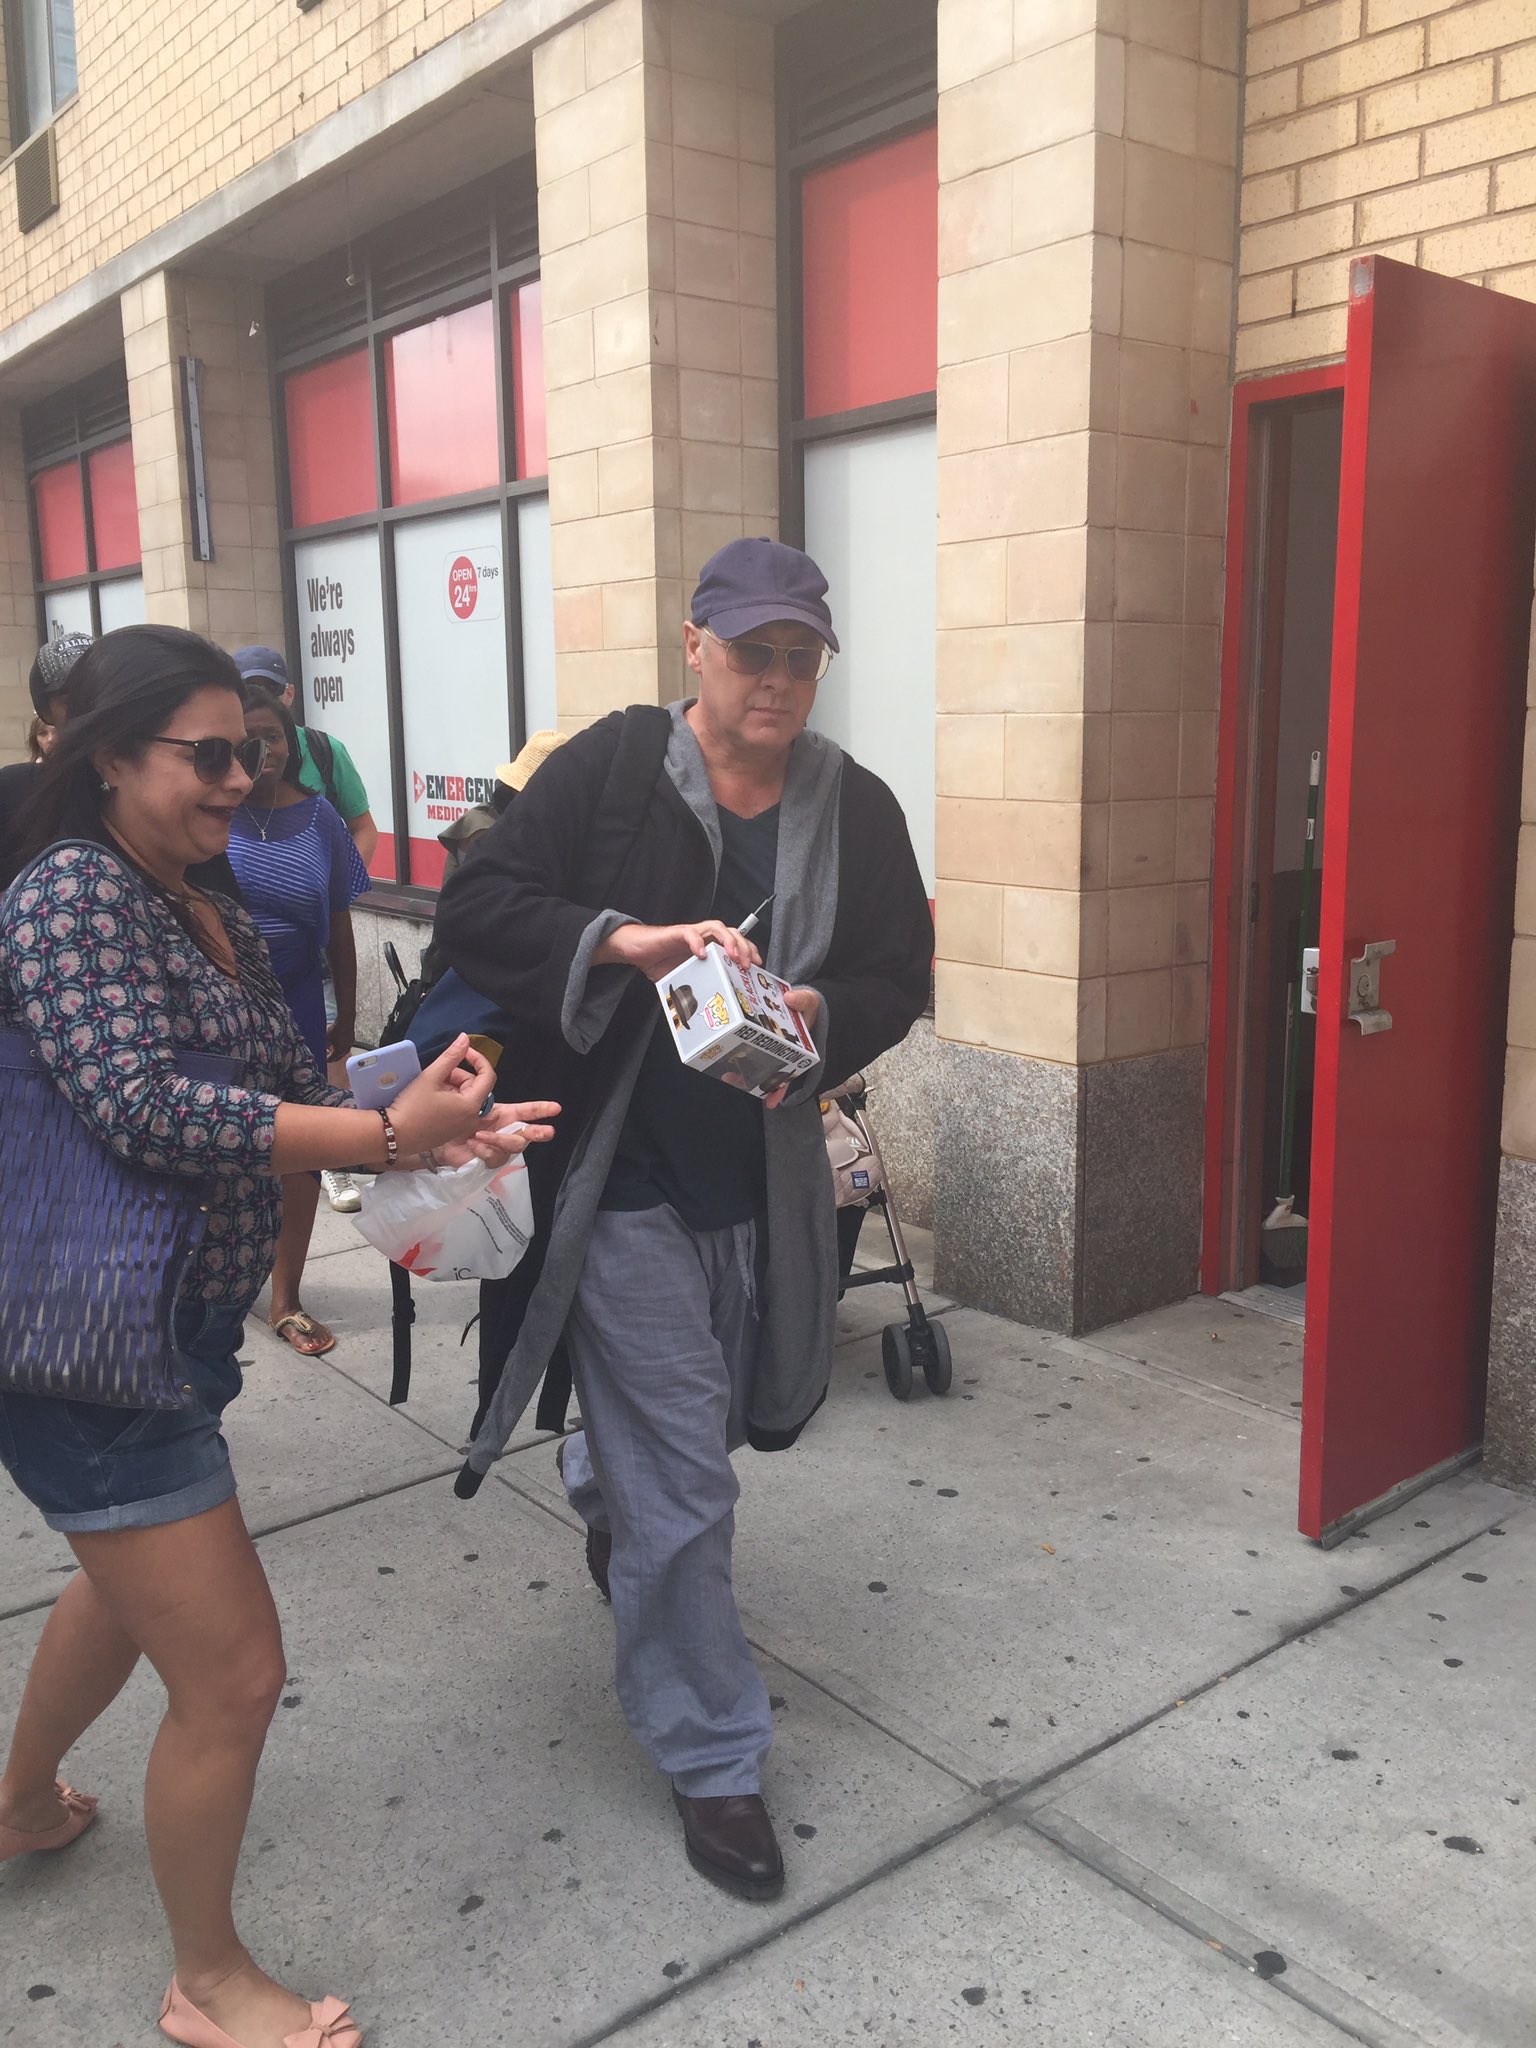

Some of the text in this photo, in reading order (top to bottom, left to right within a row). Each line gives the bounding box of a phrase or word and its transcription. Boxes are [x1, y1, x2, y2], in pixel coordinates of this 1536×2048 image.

[452, 567, 472, 582] OPEN
[482, 566, 499, 579] days
[307, 576, 343, 612] We're
[311, 624, 355, 663] always
[313, 675, 344, 710] open
[733, 1025, 758, 1041] RED
[750, 1033, 805, 1064] REDDINGTON
